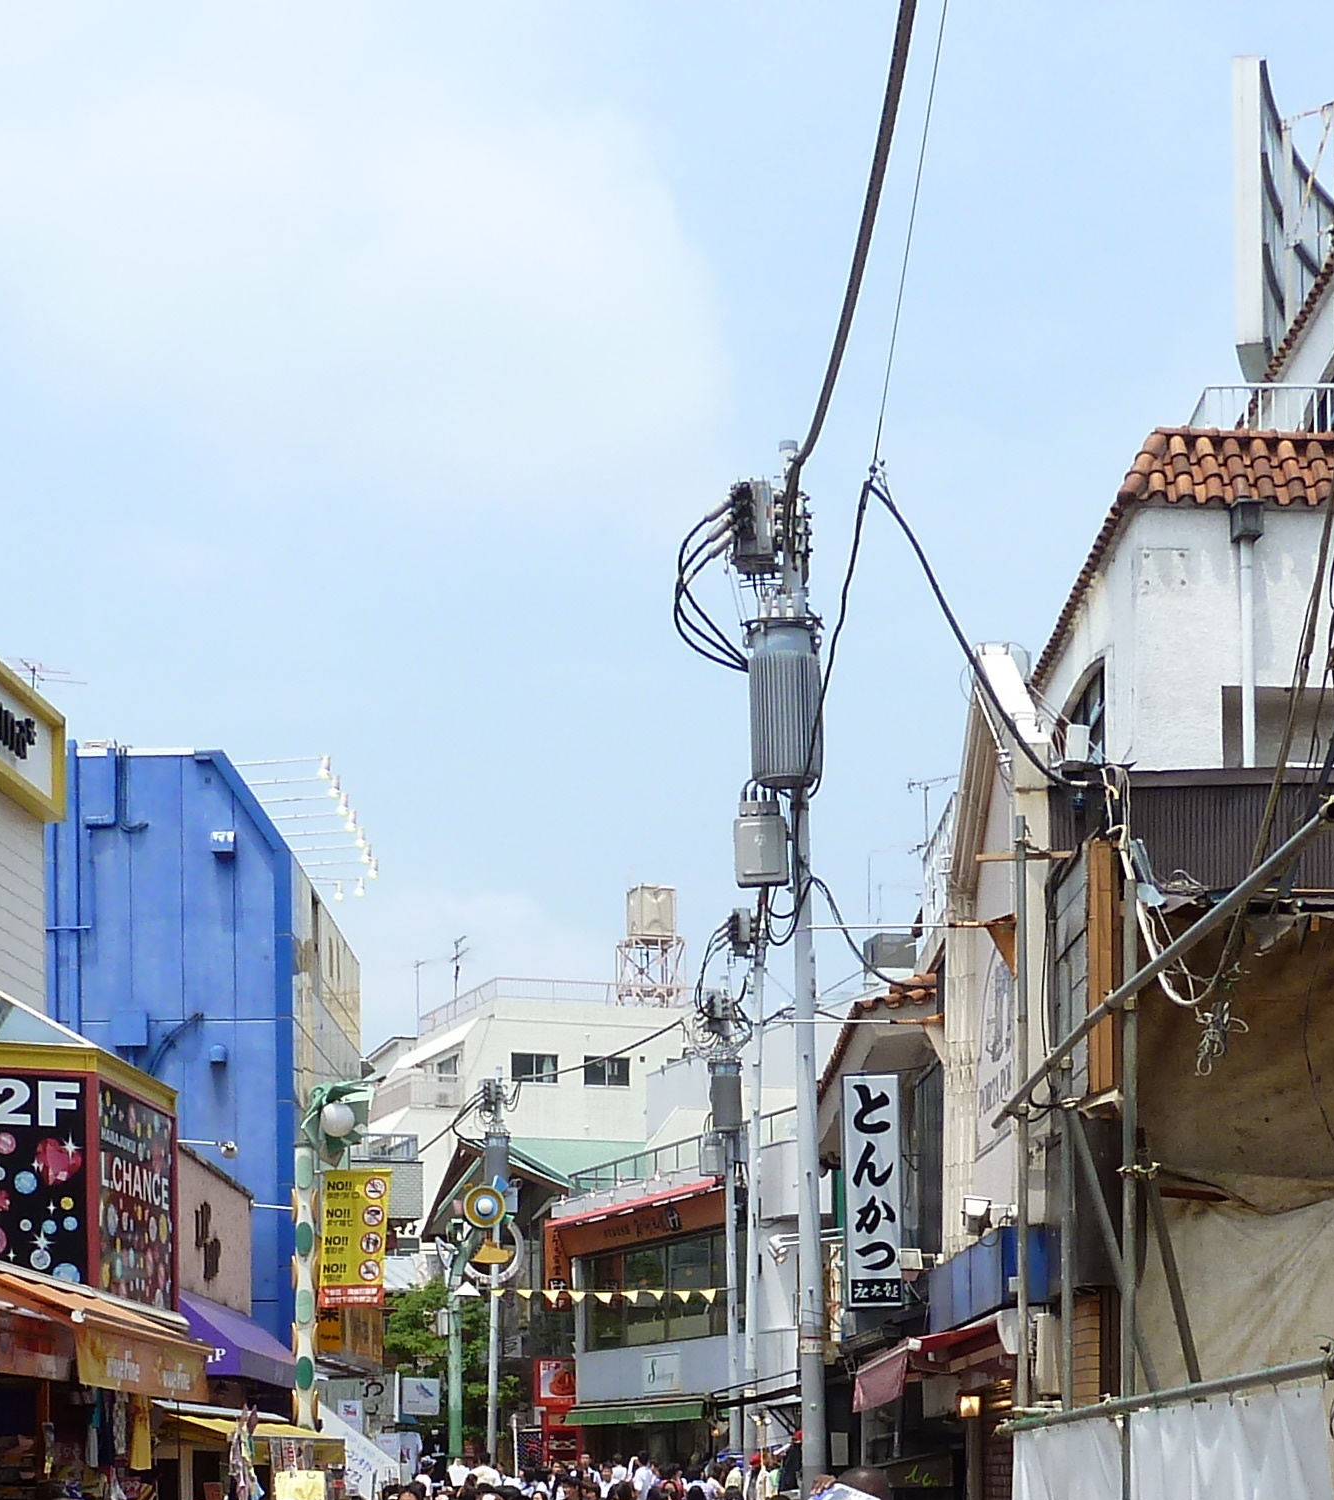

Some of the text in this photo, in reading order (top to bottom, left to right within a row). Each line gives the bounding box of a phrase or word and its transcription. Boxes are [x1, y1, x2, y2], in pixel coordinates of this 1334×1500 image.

[101, 1150, 170, 1211] L.CHANCE
[853, 1083, 896, 1271] とんかつ
[326, 1181, 352, 1192] NO!!
[325, 1208, 350, 1219] NO!!
[324, 1235, 349, 1246] NO!!
[322, 1263, 347, 1274] NO!!
